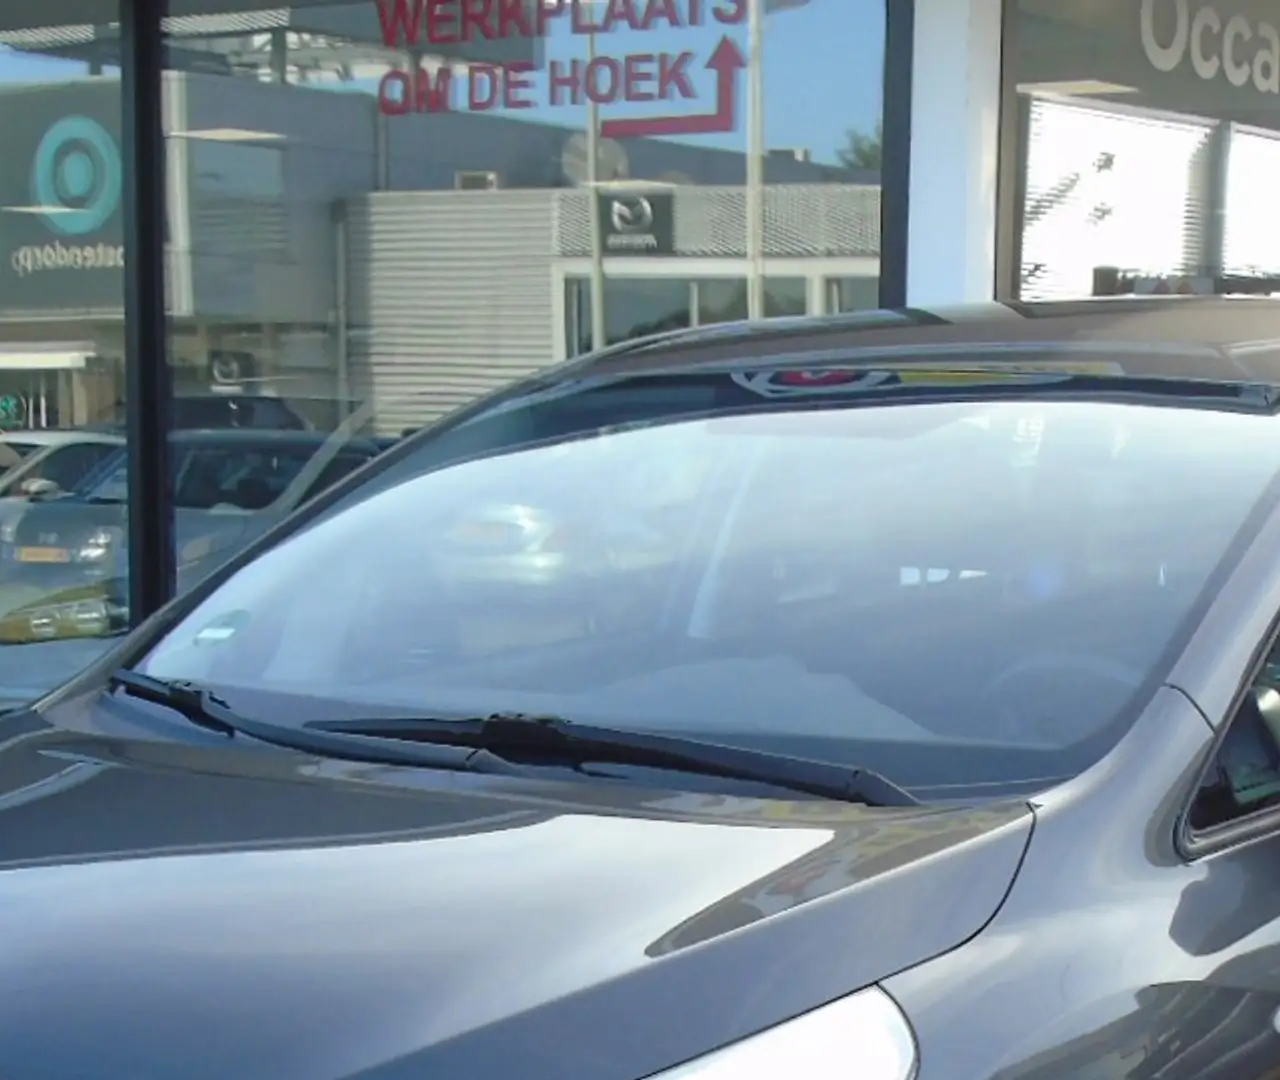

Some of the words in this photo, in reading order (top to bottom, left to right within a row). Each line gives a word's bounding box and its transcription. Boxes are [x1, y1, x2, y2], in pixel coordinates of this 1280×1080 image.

[378, 0, 747, 48] WERKPLAATS
[378, 66, 451, 116] OM
[468, 60, 537, 111] DE
[549, 52, 698, 105] HOEK
